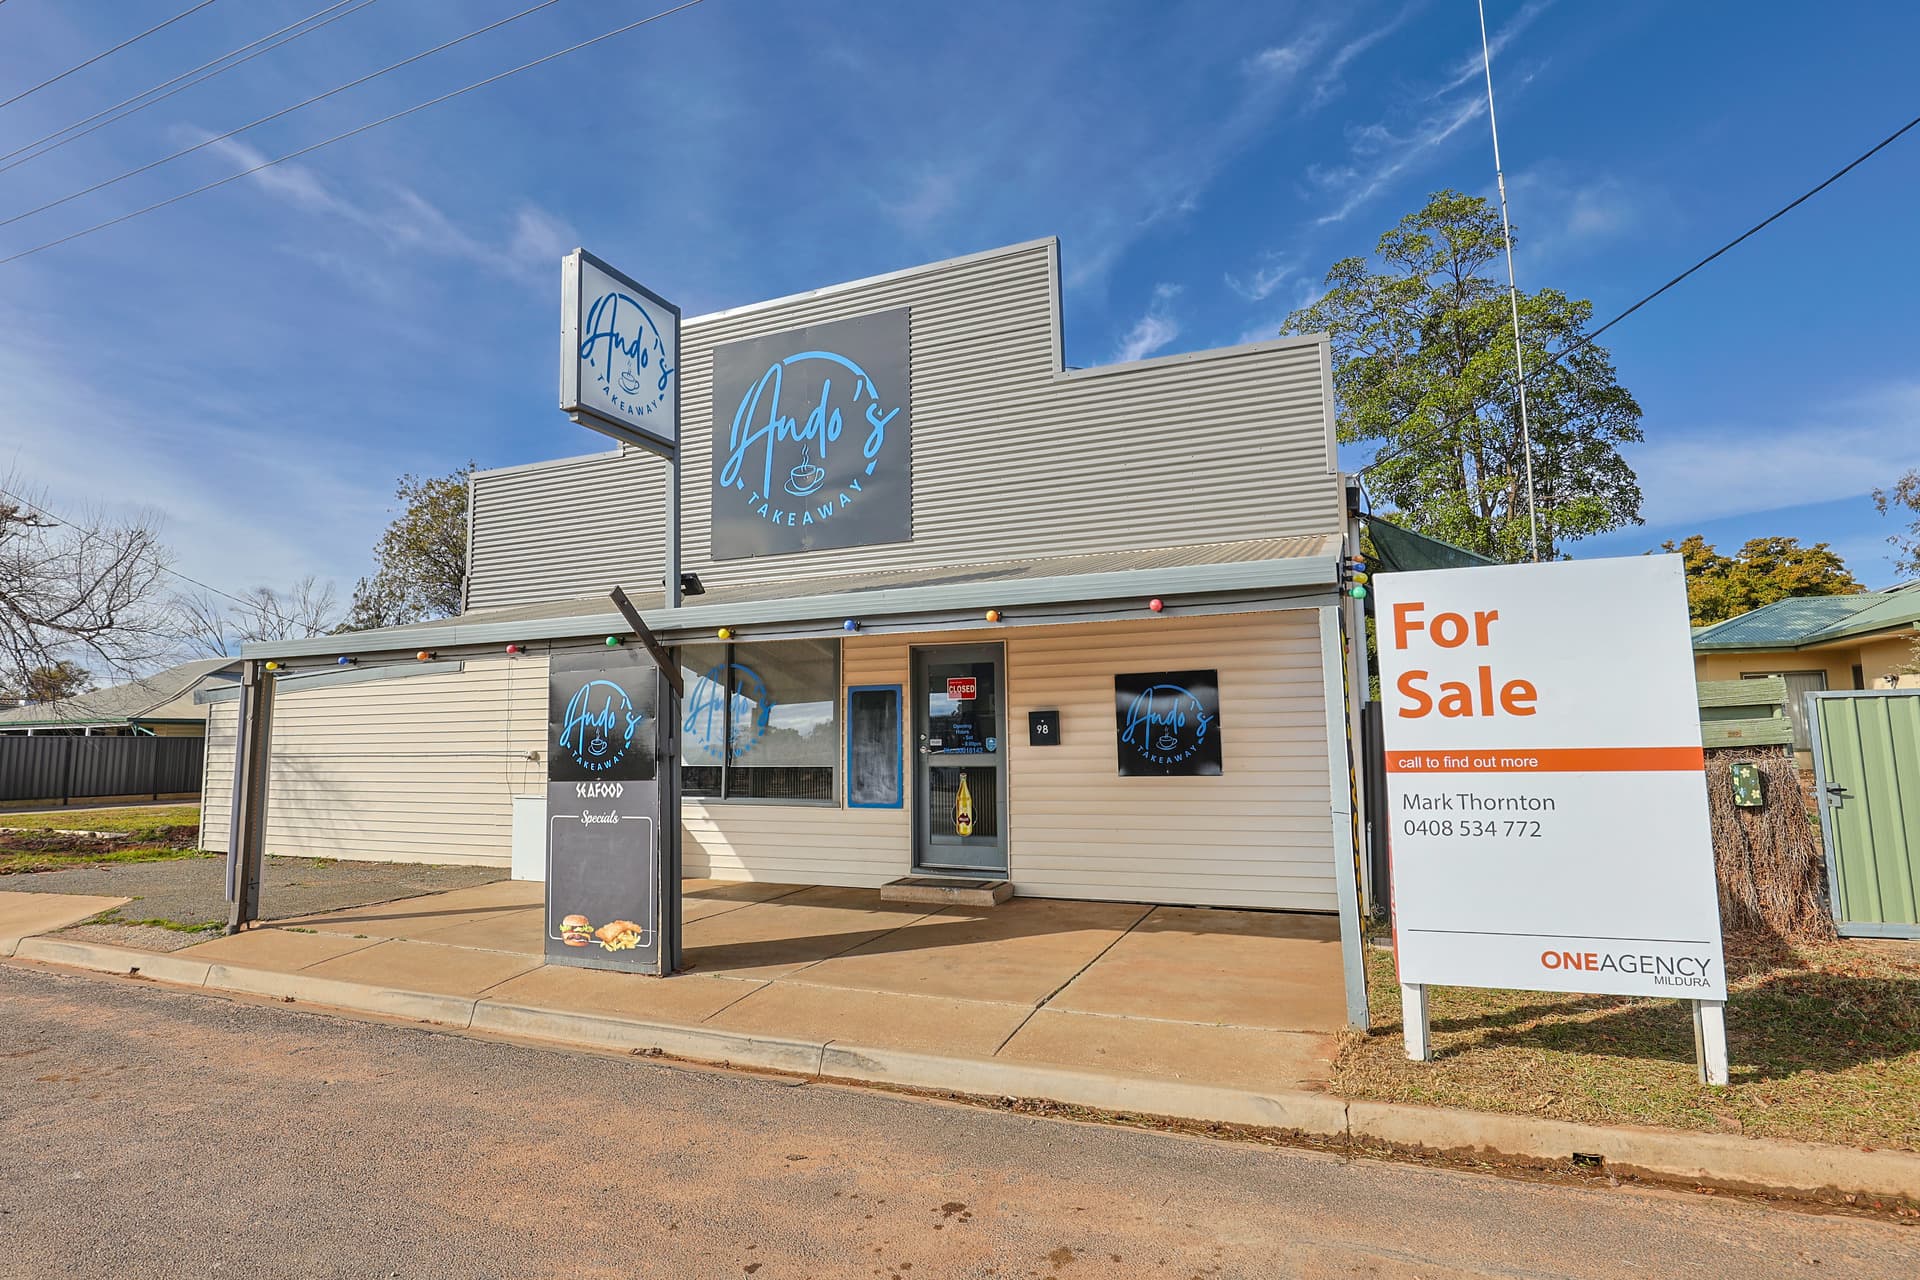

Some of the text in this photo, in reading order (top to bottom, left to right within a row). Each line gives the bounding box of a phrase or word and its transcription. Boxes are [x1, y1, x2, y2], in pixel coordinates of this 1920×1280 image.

[580, 292, 675, 384] Ando's
[597, 374, 659, 416] TAKEAWAY
[720, 362, 900, 500] Ando's
[747, 478, 863, 527] TAKEAWAY
[1392, 602, 1499, 650] For
[948, 685, 975, 693] CLOSED
[1396, 665, 1538, 719] Sale
[559, 683, 642, 756] Ando's
[1036, 724, 1049, 734] 98
[1121, 687, 1214, 750] Ando's
[571, 749, 624, 771] TAKEAWAY
[1137, 744, 1197, 764] TAKEAWAY
[1398, 756, 1539, 768] call to find out more
[576, 782, 624, 798] SEAFOOD
[1403, 793, 1555, 811] Mark Thornton
[581, 810, 619, 827] Specials
[1404, 819, 1542, 837] 0408 534 772
[1654, 975, 1711, 987] MILDURA
